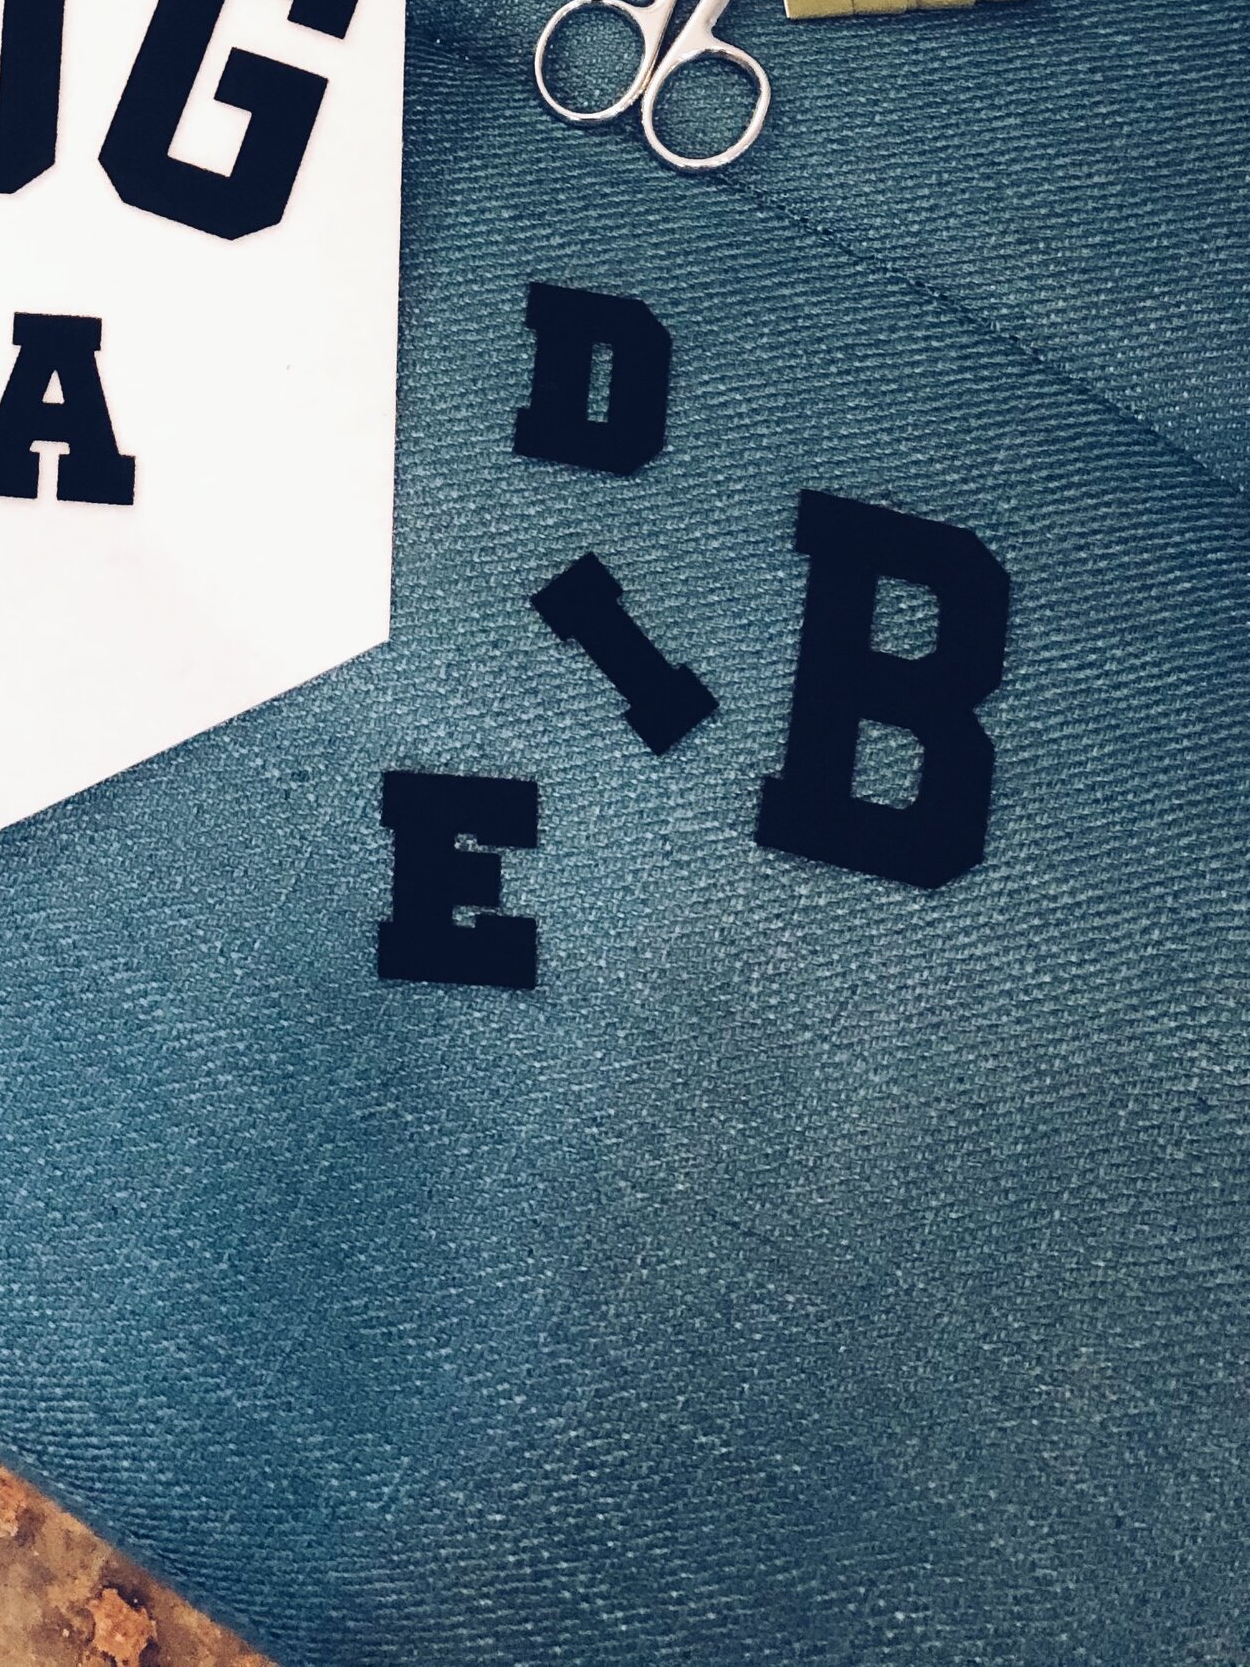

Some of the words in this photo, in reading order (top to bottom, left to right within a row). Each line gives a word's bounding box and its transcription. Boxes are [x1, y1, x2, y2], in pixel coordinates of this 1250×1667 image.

[513, 281, 672, 476] D
[531, 550, 720, 756] I
[754, 488, 1010, 890] B
[377, 770, 539, 990] E
